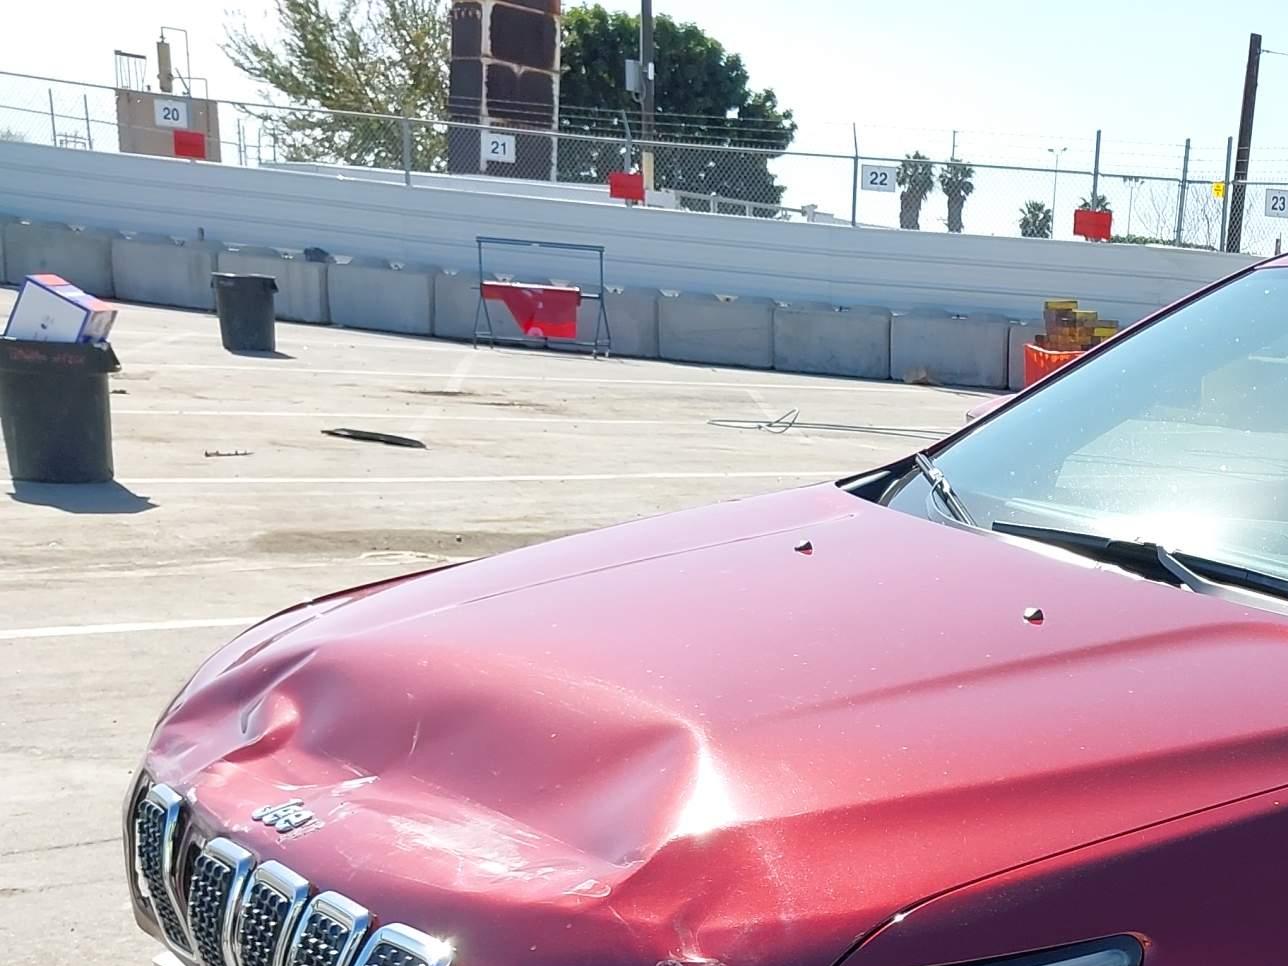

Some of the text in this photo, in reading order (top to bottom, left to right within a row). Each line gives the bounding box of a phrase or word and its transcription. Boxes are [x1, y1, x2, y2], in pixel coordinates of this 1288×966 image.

[163, 107, 180, 121] 20
[490, 141, 506, 155] 21
[870, 171, 888, 186] 22
[1271, 196, 1286, 211] 23
